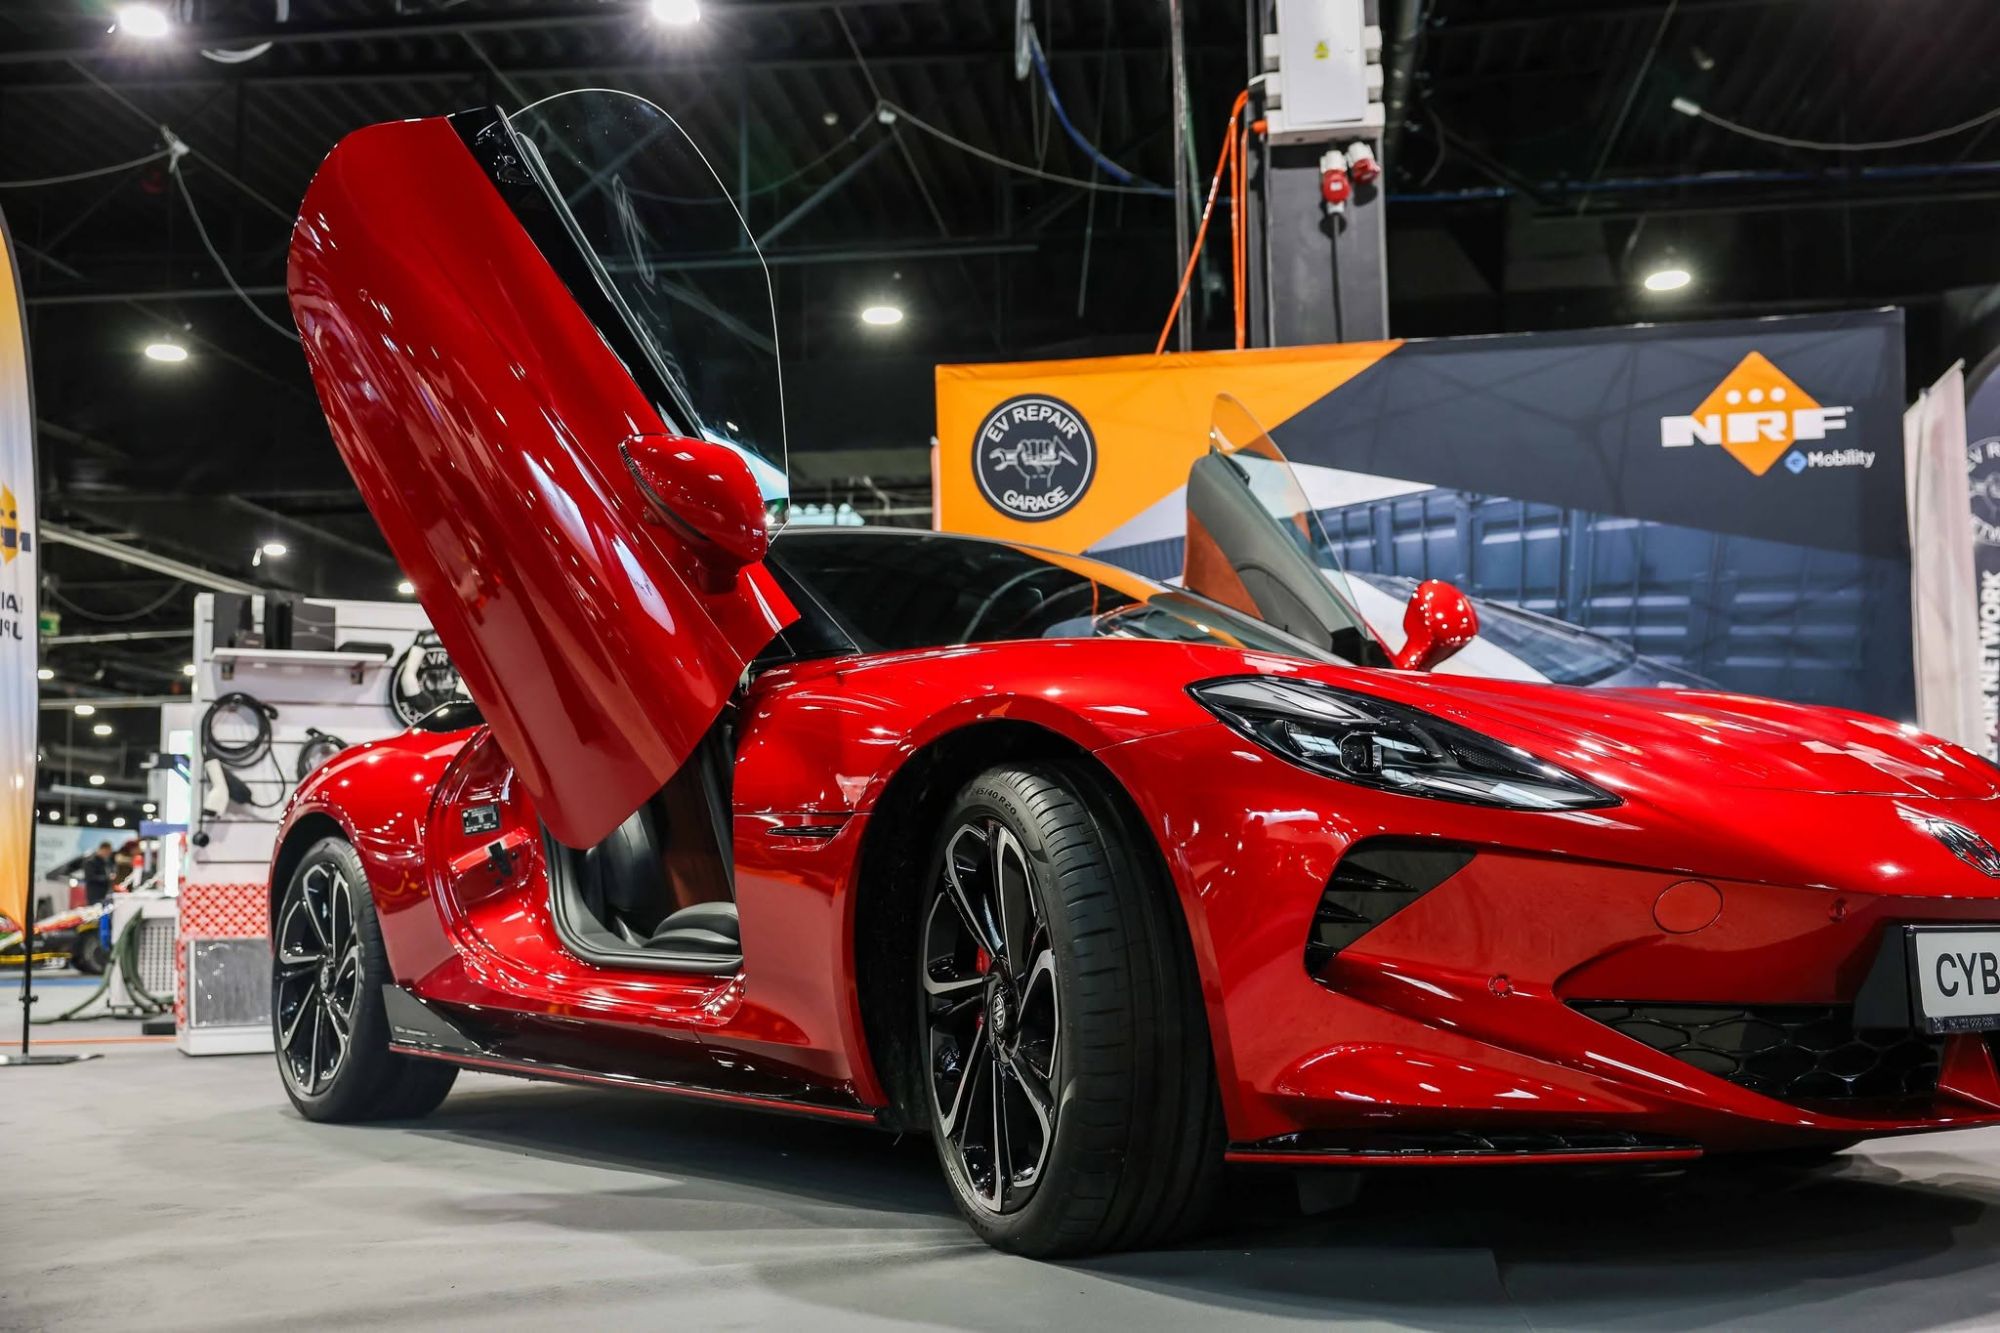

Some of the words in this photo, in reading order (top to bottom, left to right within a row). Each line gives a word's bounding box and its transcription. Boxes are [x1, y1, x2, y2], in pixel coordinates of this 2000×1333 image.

[987, 416, 1010, 443] EV
[1012, 405, 1079, 440] REPAIR
[1661, 406, 1847, 447] NRF
[1808, 449, 1876, 469] Mobility
[1003, 485, 1069, 511] GARAGE
[1936, 952, 2000, 997] CYB
